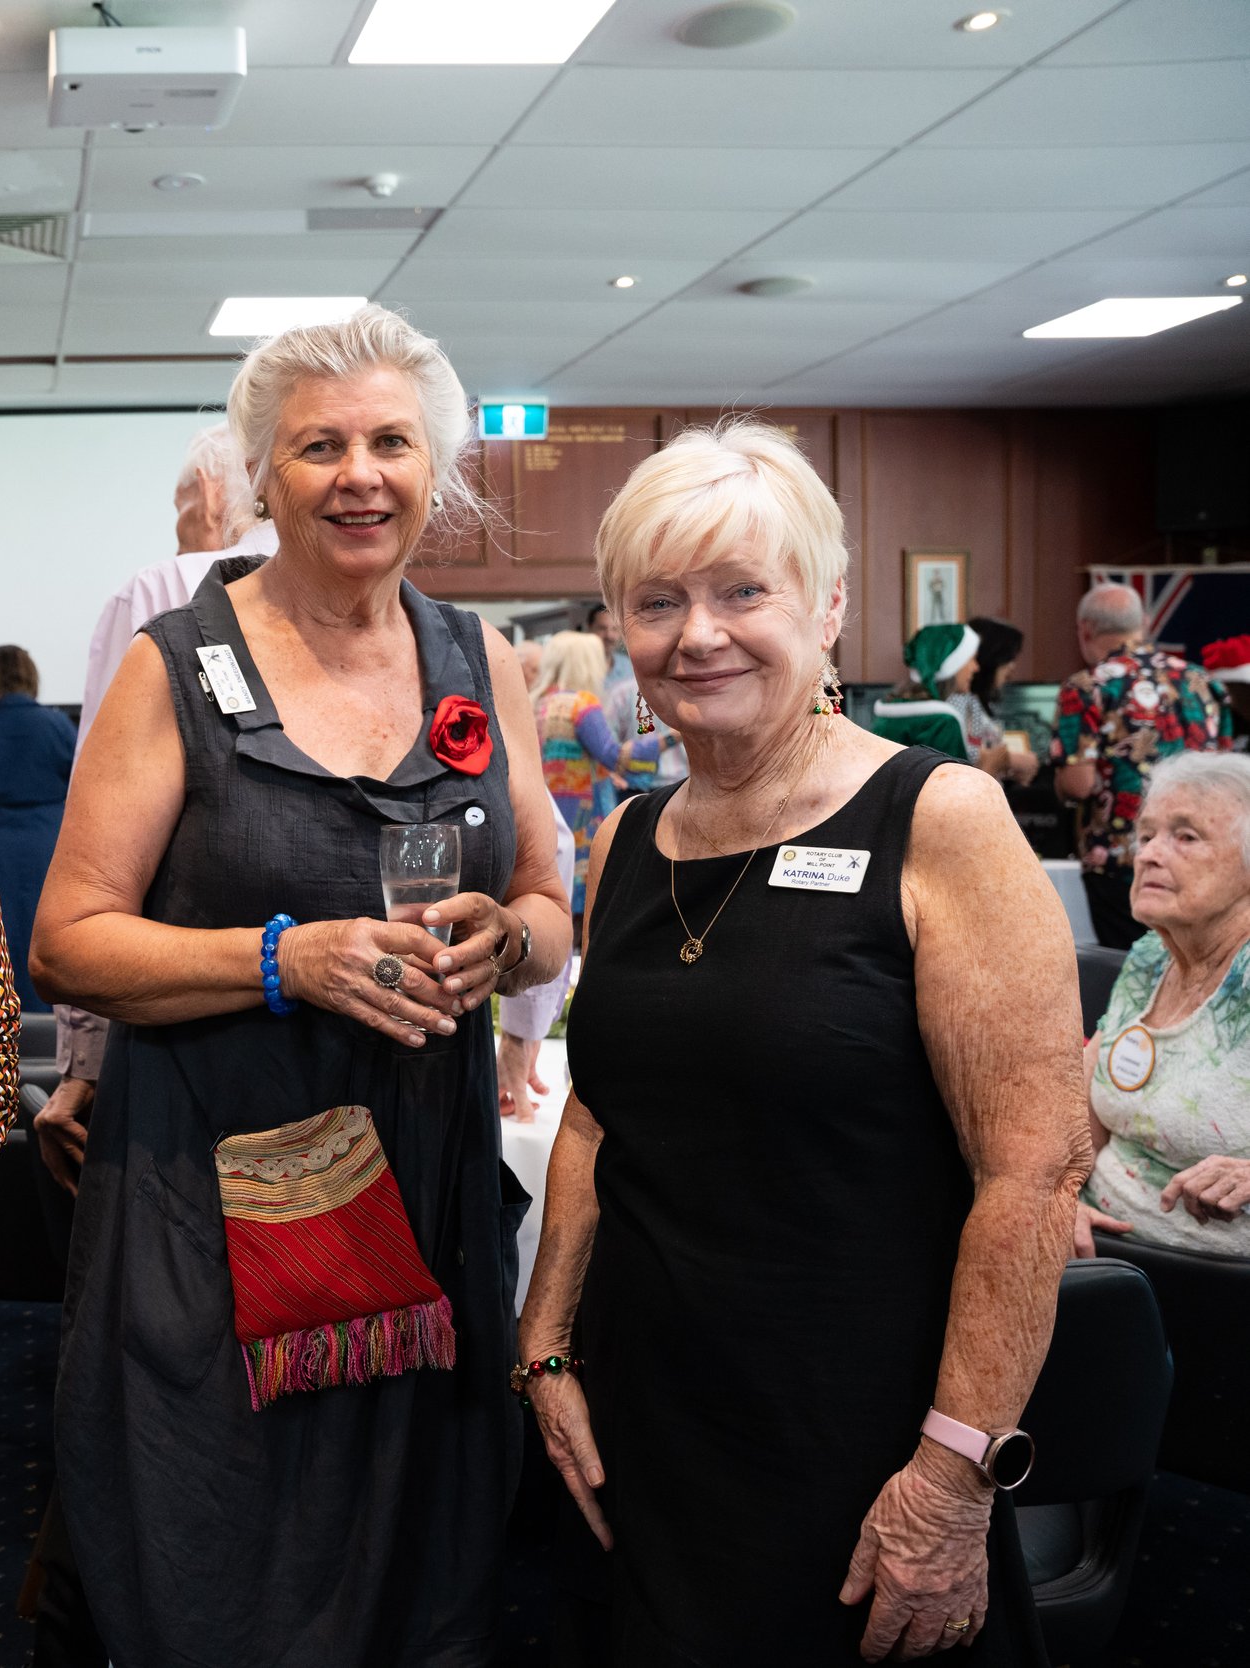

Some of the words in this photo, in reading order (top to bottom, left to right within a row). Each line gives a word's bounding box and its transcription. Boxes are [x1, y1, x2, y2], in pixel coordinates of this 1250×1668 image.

[240, 685, 252, 704] MANDY
[783, 869, 825, 880] KATRINA
[827, 873, 851, 882] Duke
